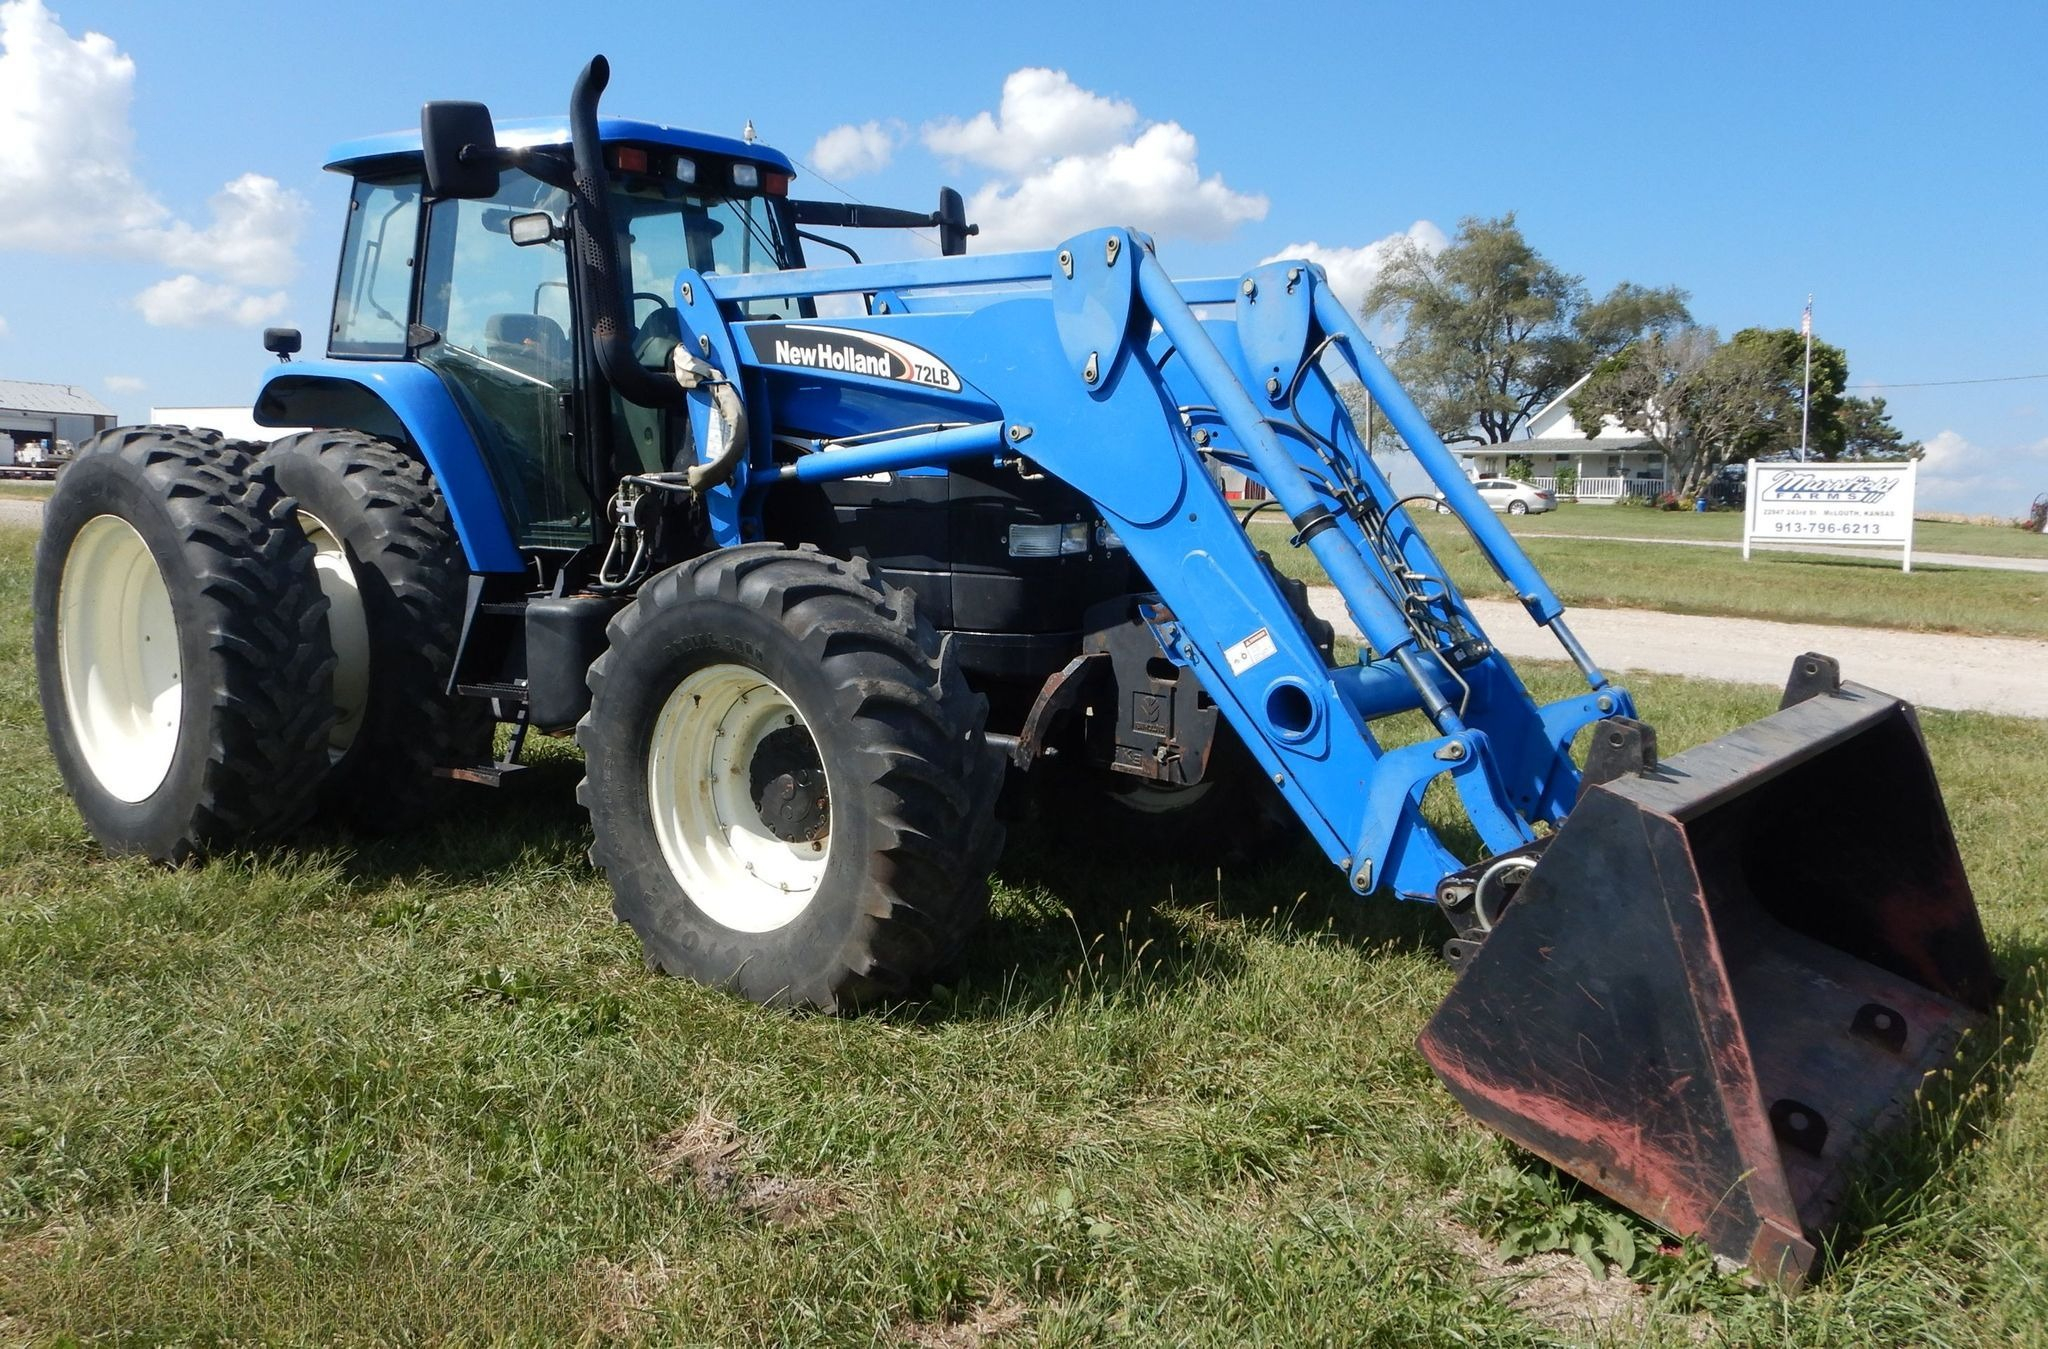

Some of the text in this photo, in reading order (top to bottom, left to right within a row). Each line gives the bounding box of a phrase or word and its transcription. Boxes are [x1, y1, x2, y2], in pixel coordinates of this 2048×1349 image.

[914, 364, 950, 386] 72LB
[1776, 492, 1857, 500] FARMS
[1775, 522, 1880, 535] 913-796-6213
